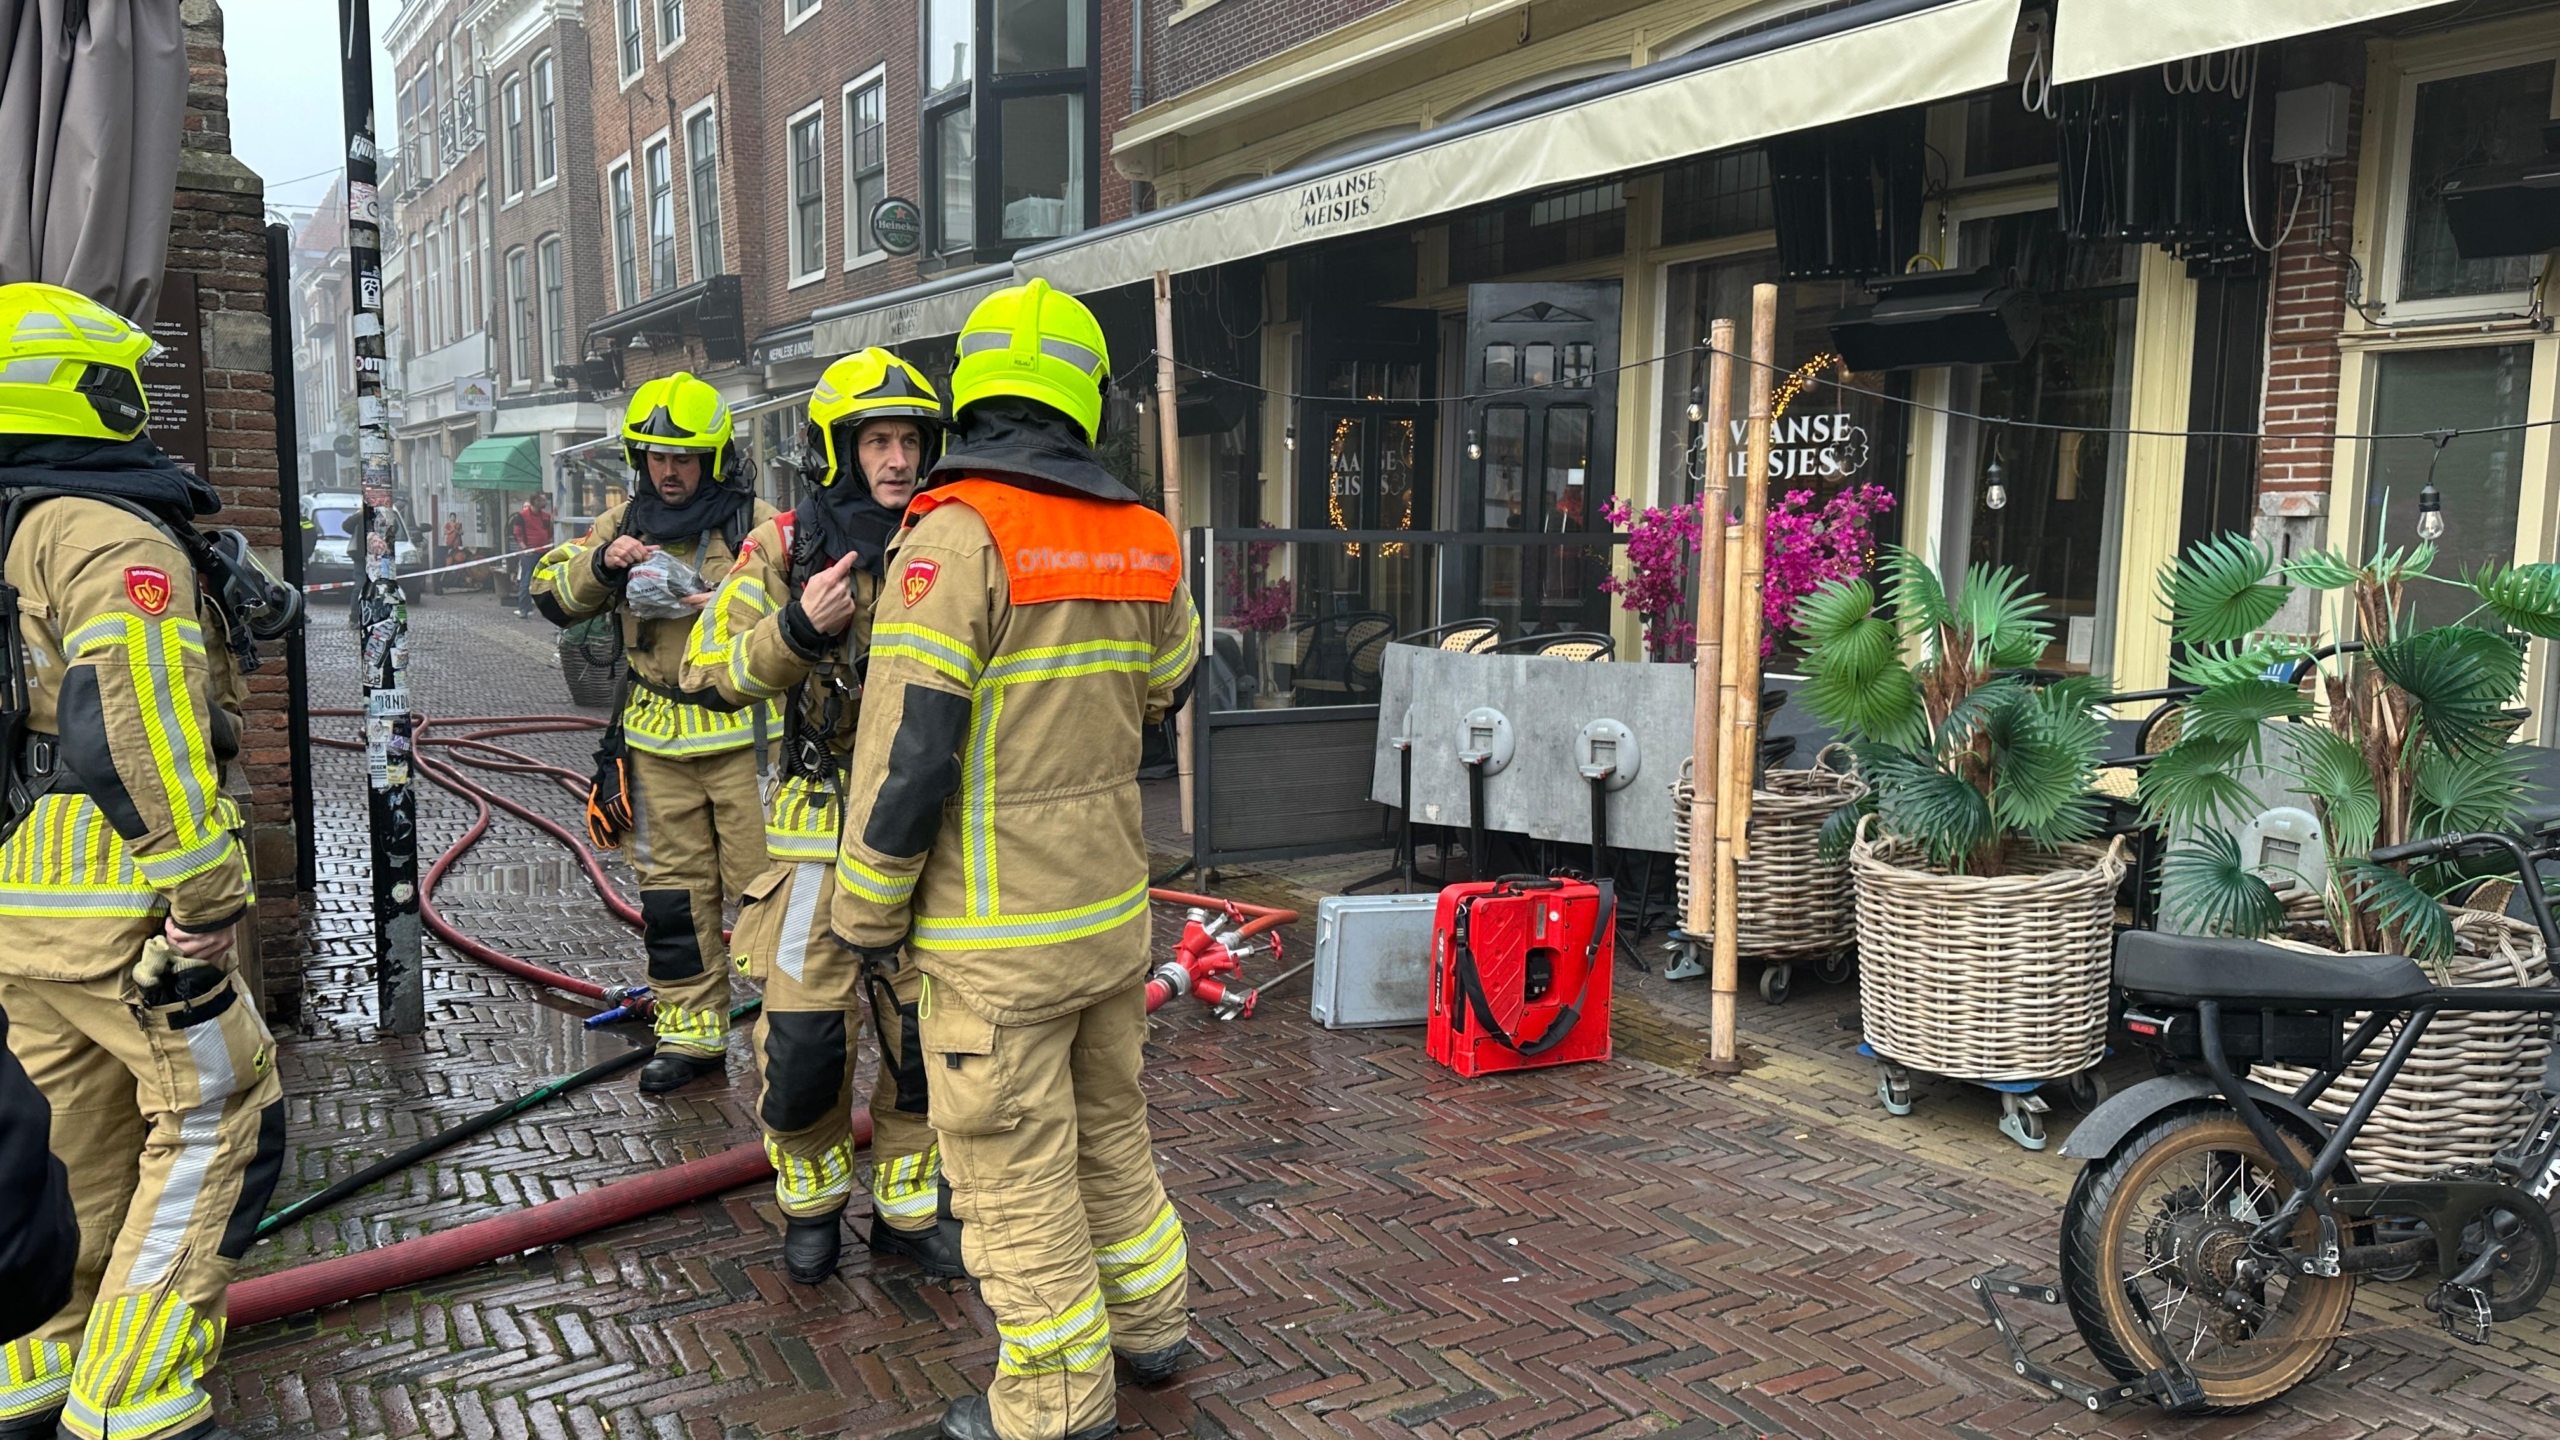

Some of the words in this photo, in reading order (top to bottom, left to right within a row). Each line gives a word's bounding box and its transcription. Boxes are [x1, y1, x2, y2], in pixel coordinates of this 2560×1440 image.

[1299, 170, 1377, 210] JAVAANSE
[1303, 195, 1370, 229] MEISJES
[769, 344, 794, 361] NEPALESE
[797, 340, 814, 354] INDIA
[1701, 413, 1851, 450] JVANSE
[1016, 548, 1087, 572] Officier
[1090, 552, 1125, 570] van
